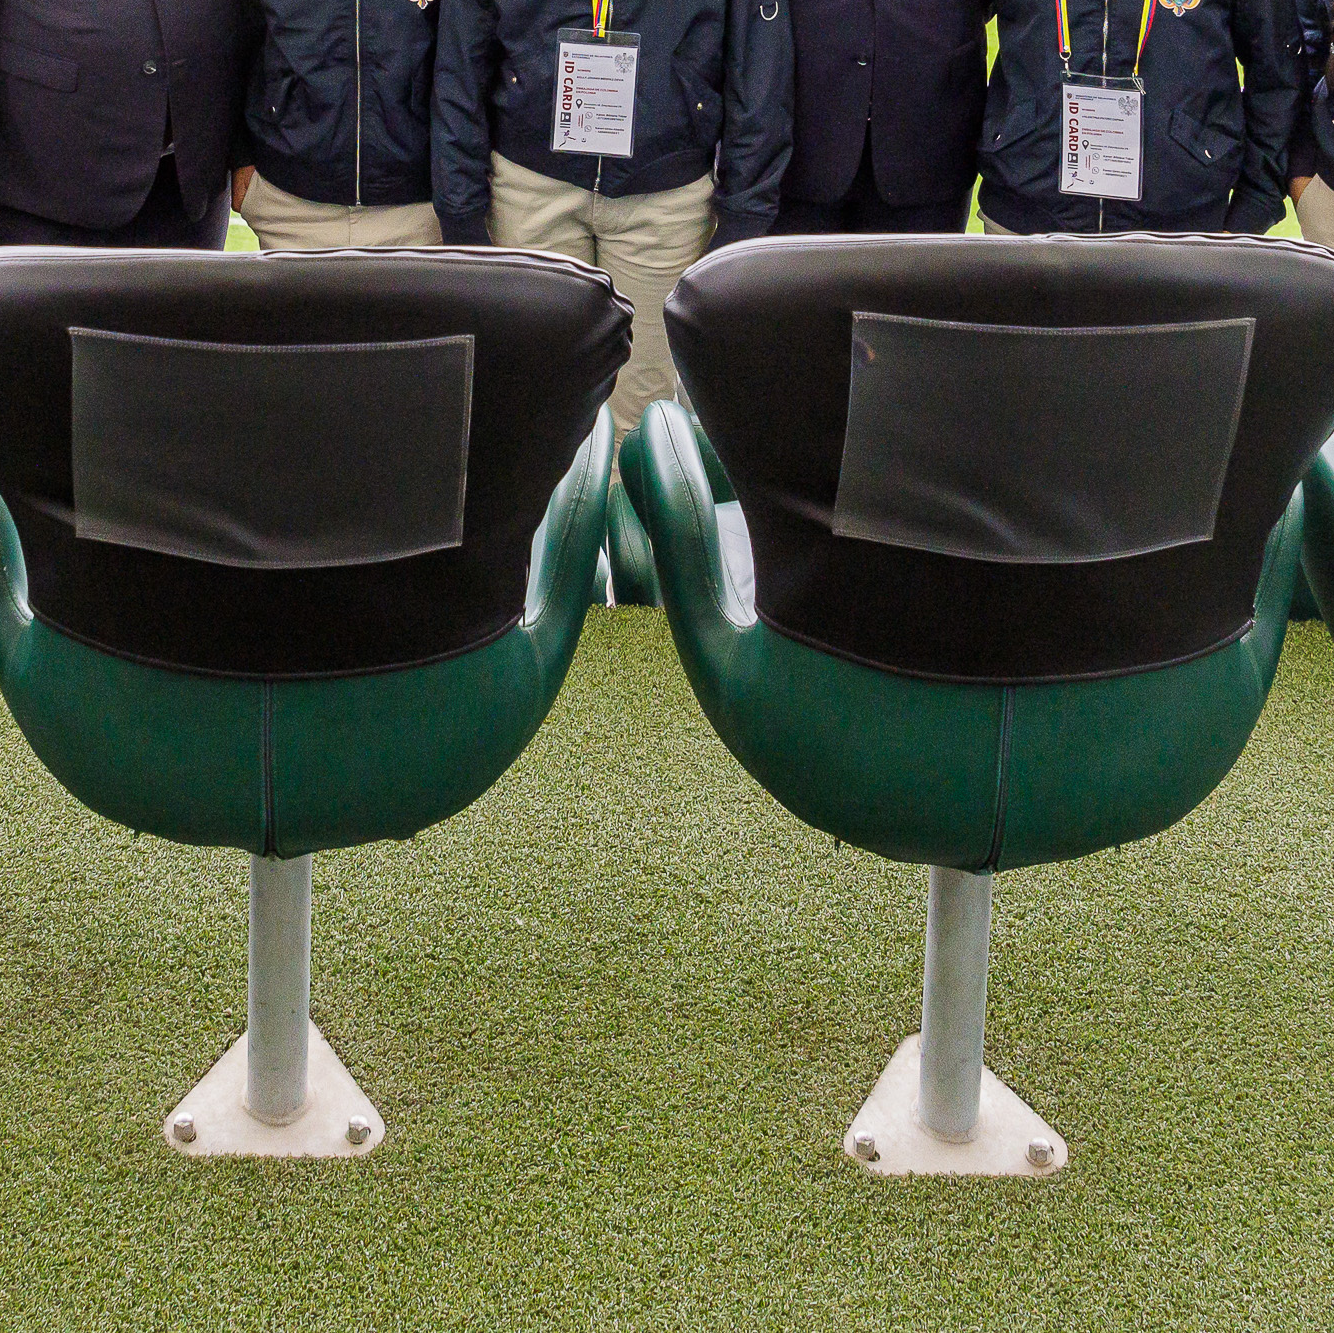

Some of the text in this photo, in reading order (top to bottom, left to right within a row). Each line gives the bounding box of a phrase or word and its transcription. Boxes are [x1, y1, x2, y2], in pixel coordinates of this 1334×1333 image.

[562, 60, 575, 111] ID CARD
[1068, 101, 1079, 152] ID CARD
